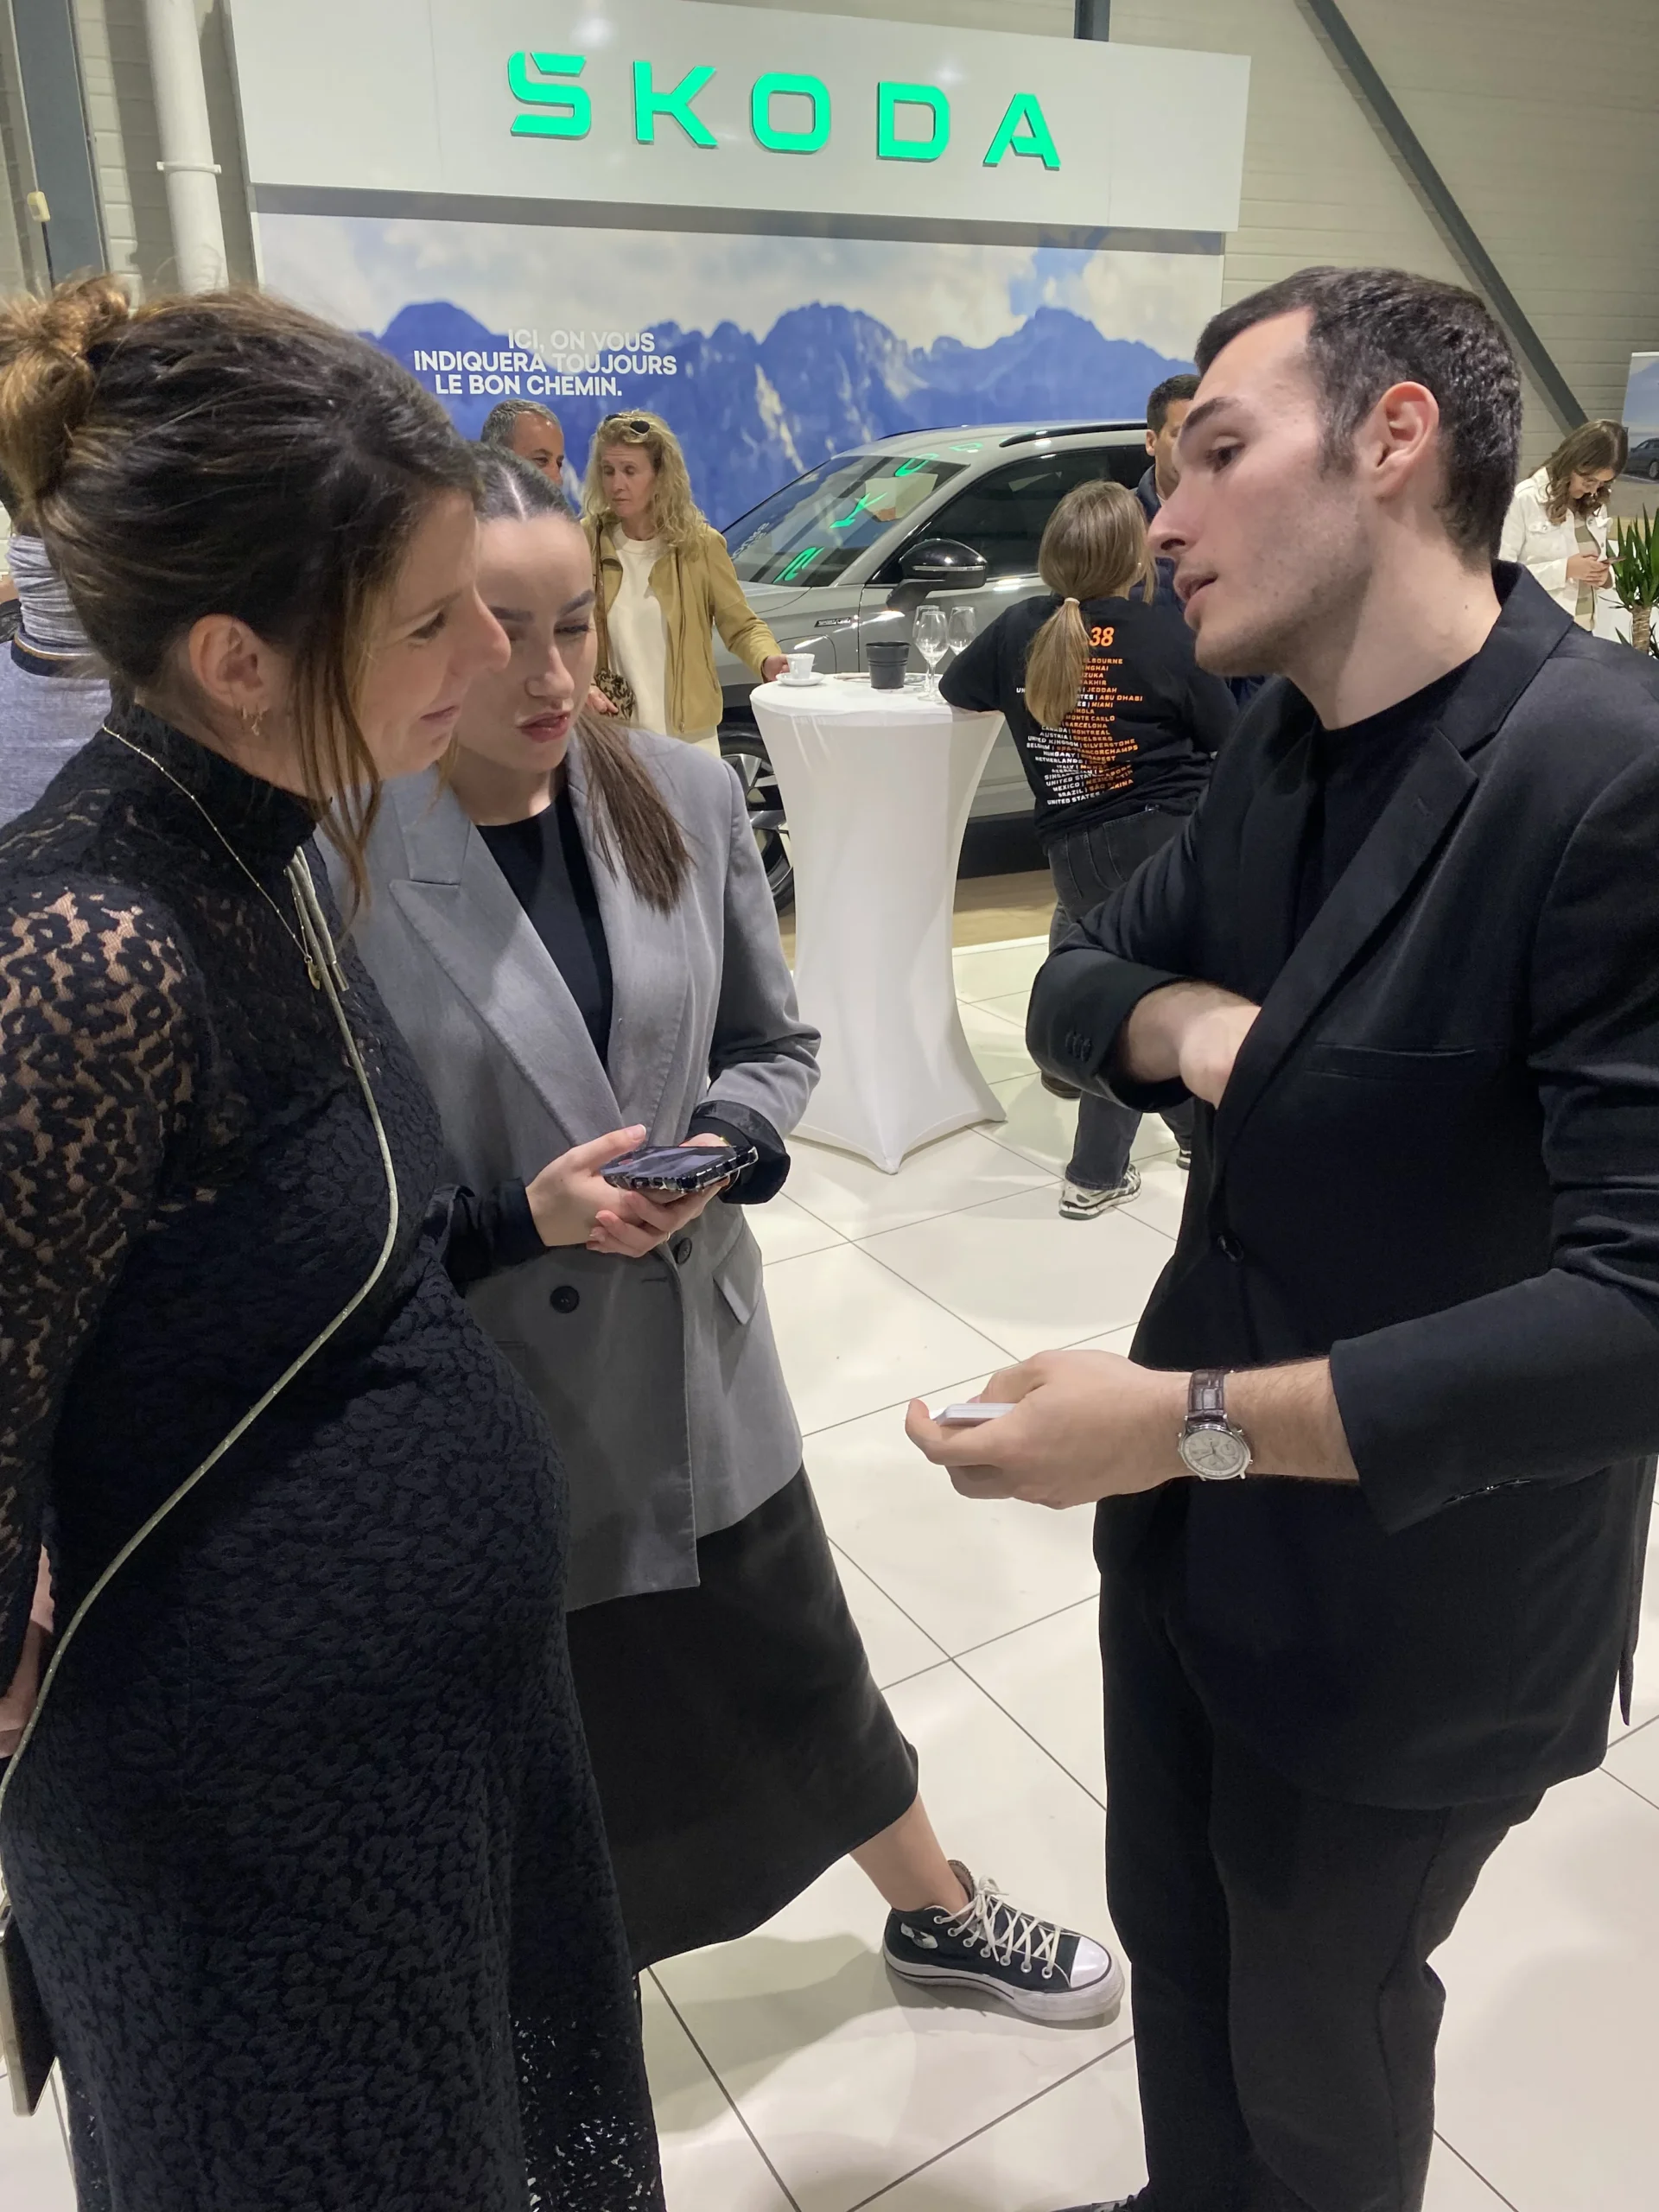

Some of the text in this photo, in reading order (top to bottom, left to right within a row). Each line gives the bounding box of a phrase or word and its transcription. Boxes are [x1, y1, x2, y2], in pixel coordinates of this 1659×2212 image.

[507, 50, 1061, 172] SKODA
[508, 328, 655, 353] ICI, ON VOUS
[413, 350, 677, 375] INDIQUERA TOUJOURS
[435, 374, 623, 396] LE BON CHEMIN.
[1089, 626, 1115, 646] 38
[1039, 732, 1069, 741] AUSTRIA
[1083, 738, 1135, 748] SILVERSTONE
[1046, 777, 1073, 786] UNITED
[1052, 782, 1080, 792] MEXICO
[1058, 789, 1084, 798] BRAZIL
